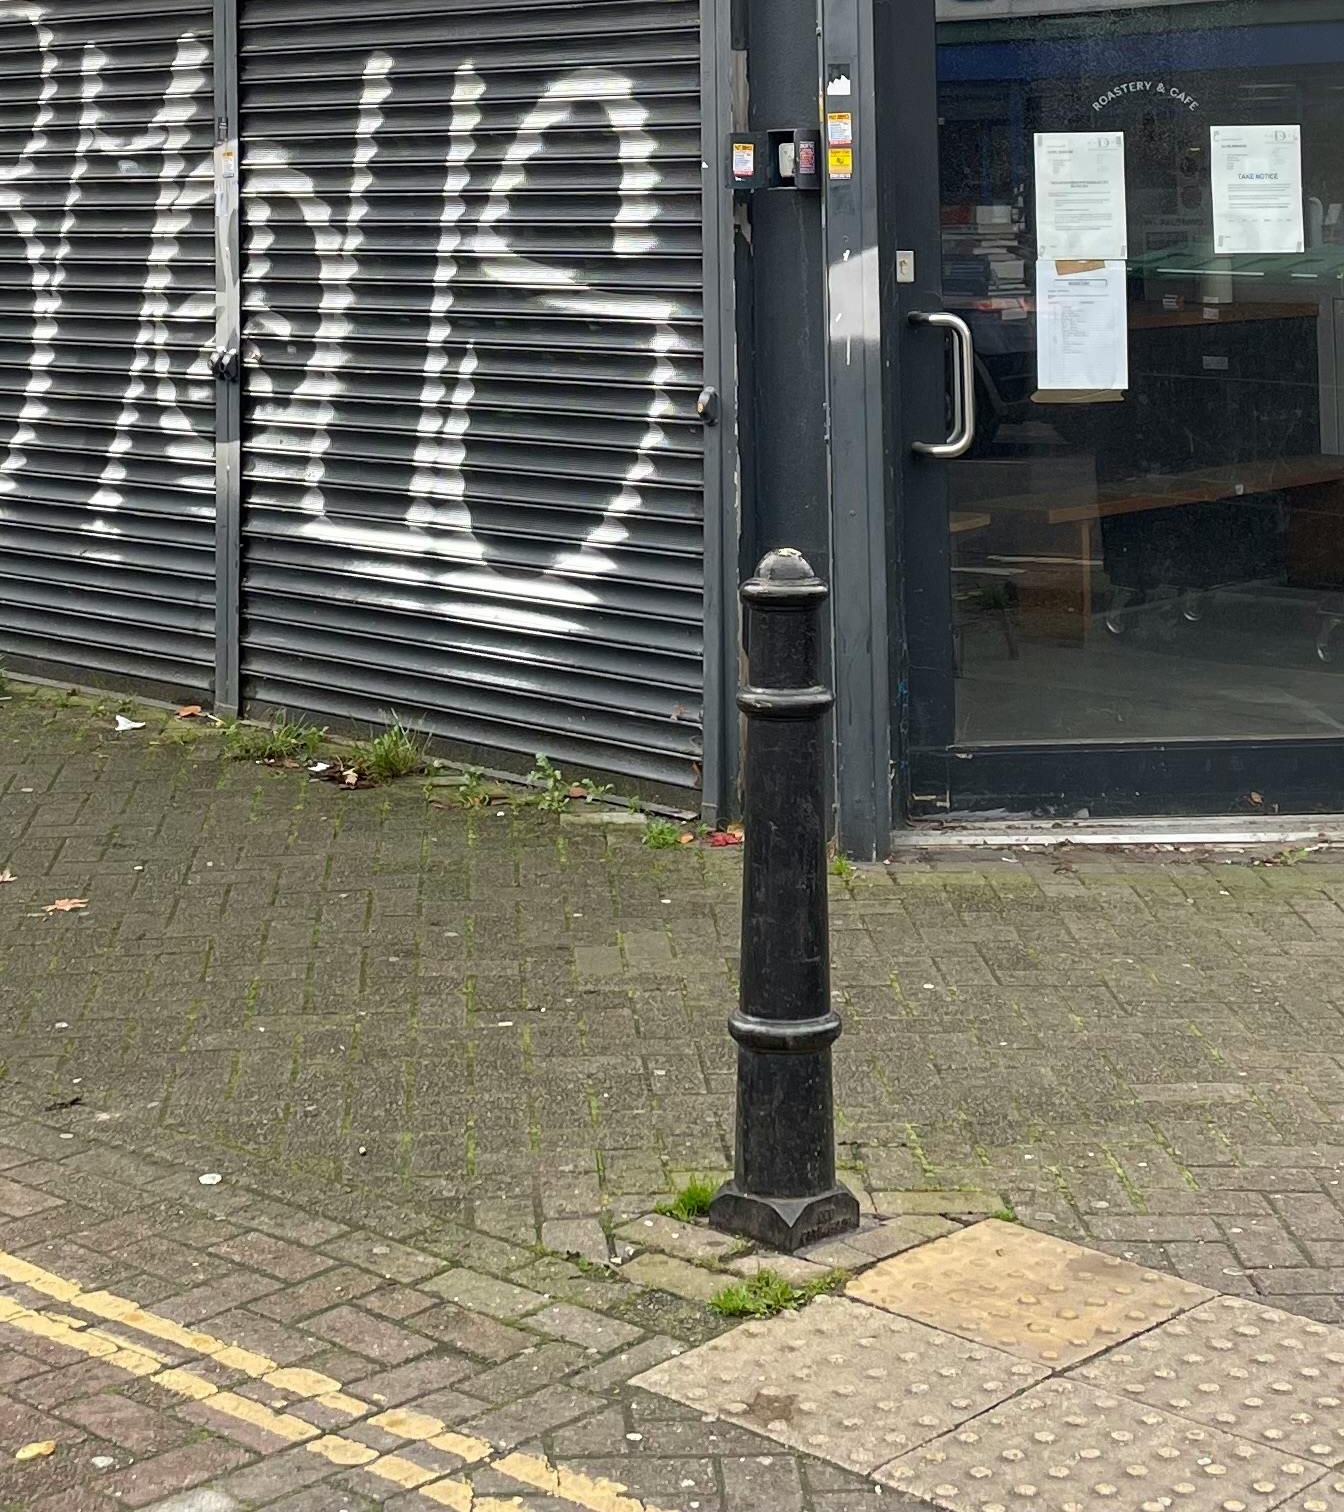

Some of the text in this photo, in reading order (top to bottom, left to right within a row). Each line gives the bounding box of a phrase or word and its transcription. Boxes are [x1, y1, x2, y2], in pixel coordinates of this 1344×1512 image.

[1092, 81, 1199, 111] ROASTERY & CAFE
